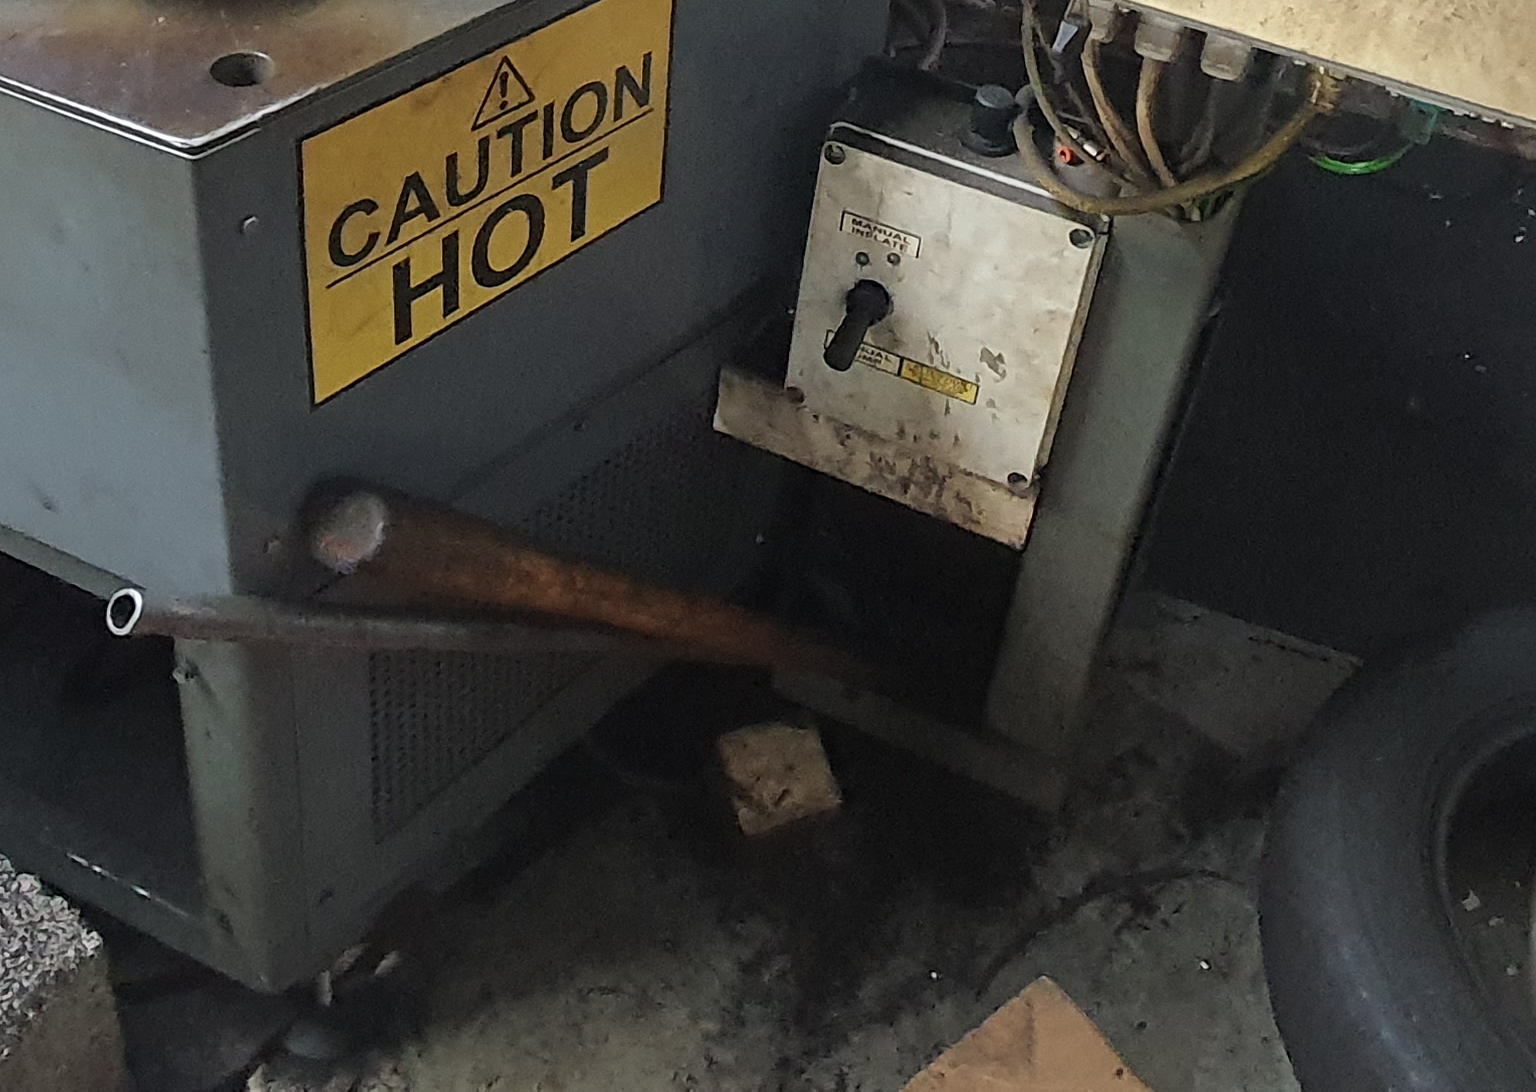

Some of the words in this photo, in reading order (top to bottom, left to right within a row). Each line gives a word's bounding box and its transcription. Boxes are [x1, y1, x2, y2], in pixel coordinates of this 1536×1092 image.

[327, 50, 654, 267] CAUTION
[392, 145, 610, 345] HOT
[851, 217, 910, 245] MANUAL
[851, 226, 908, 252] INFLATE
